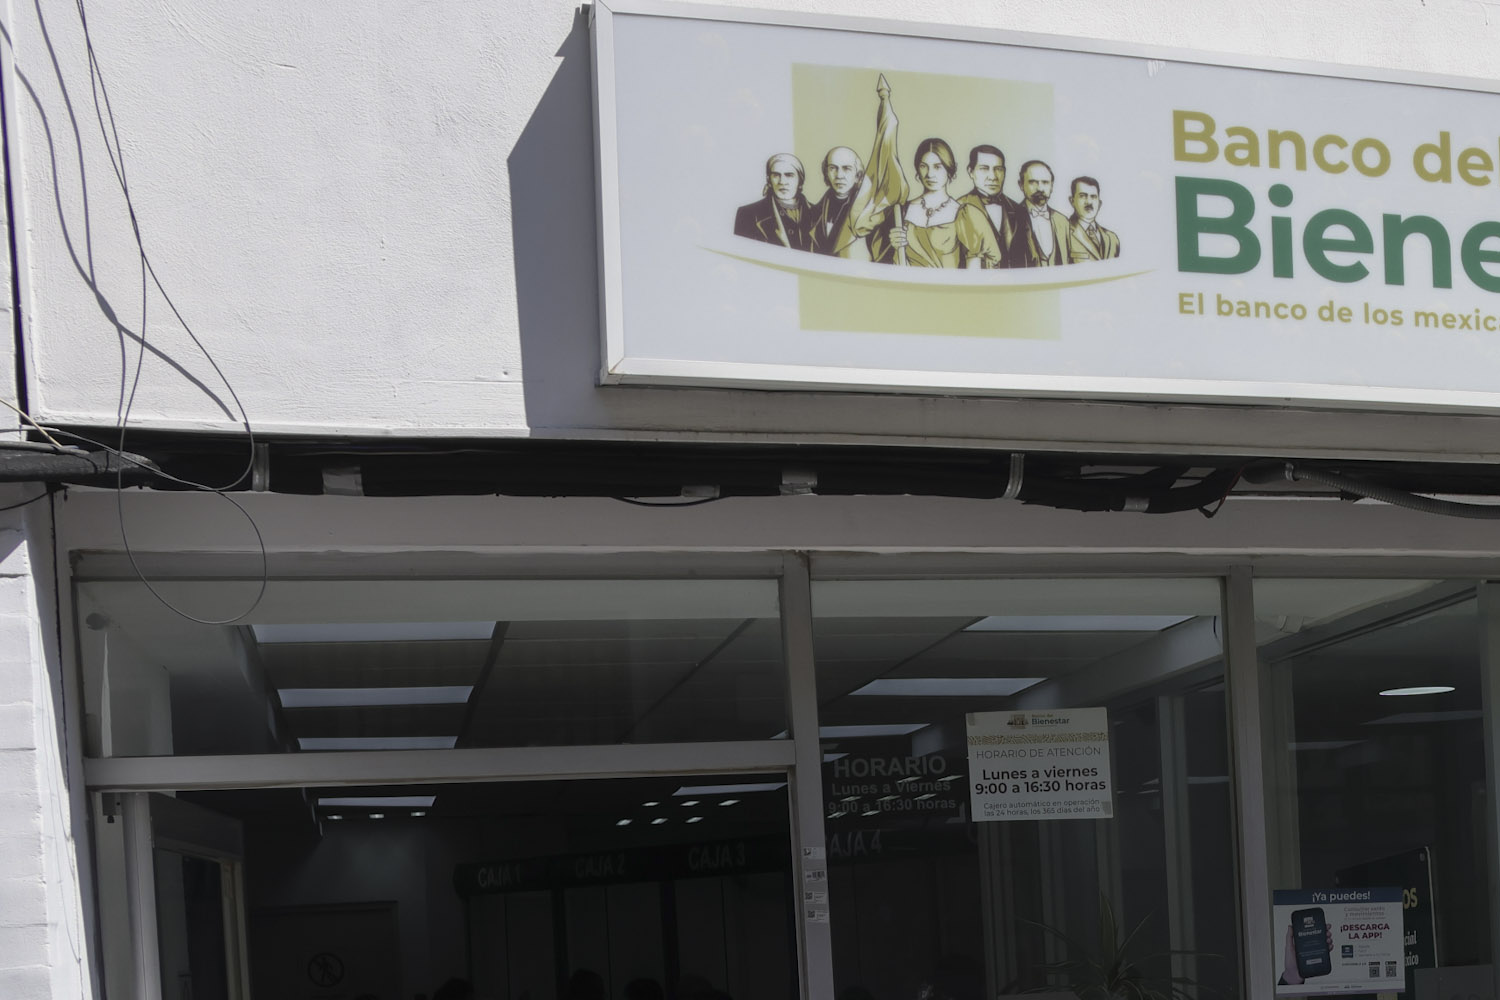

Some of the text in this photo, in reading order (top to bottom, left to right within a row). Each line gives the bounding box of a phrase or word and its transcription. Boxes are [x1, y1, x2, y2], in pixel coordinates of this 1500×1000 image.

[1174, 111, 1390, 177] Banco
[1179, 293, 1203, 314] El
[1217, 295, 1307, 321] banco
[1318, 302, 1353, 323] de
[1364, 304, 1403, 326] los
[1031, 717, 1070, 726] Bienestar
[976, 745, 1101, 760] HORARIO DE ATENCIÓN
[833, 755, 947, 779] HORARIO
[982, 766, 1098, 780] Lunes a viernes
[832, 780, 952, 796] Lunes a Viernes
[975, 780, 1106, 795] 9:00 a 16:30 horas
[828, 796, 957, 814] 9:00 a 16:30 horas
[983, 802, 1007, 811] Cajero
[826, 830, 868, 858] AJA
[688, 847, 732, 871] CAJA
[1312, 890, 1371, 903] ¡Ya puedes!
[1340, 923, 1390, 933] ¡DESCARGA
[1348, 931, 1383, 940] LA APP!
